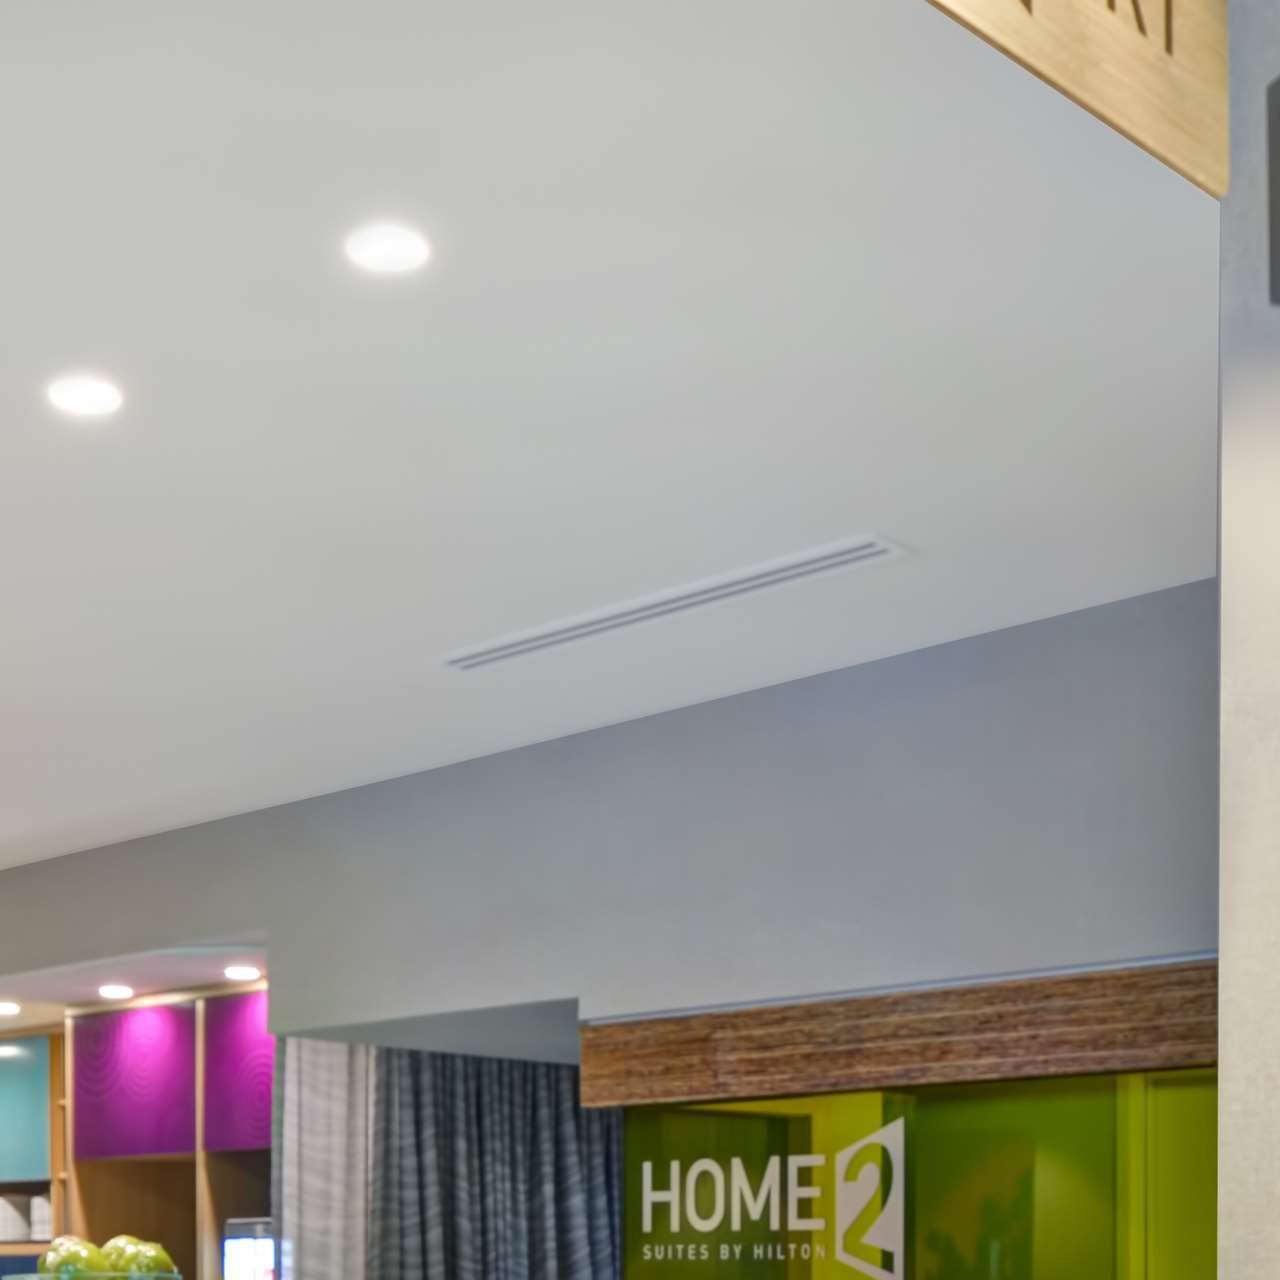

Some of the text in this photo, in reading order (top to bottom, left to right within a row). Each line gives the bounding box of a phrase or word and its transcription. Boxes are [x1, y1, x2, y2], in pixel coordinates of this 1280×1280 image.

[643, 1243, 826, 1261] SUITES BY HILTON
